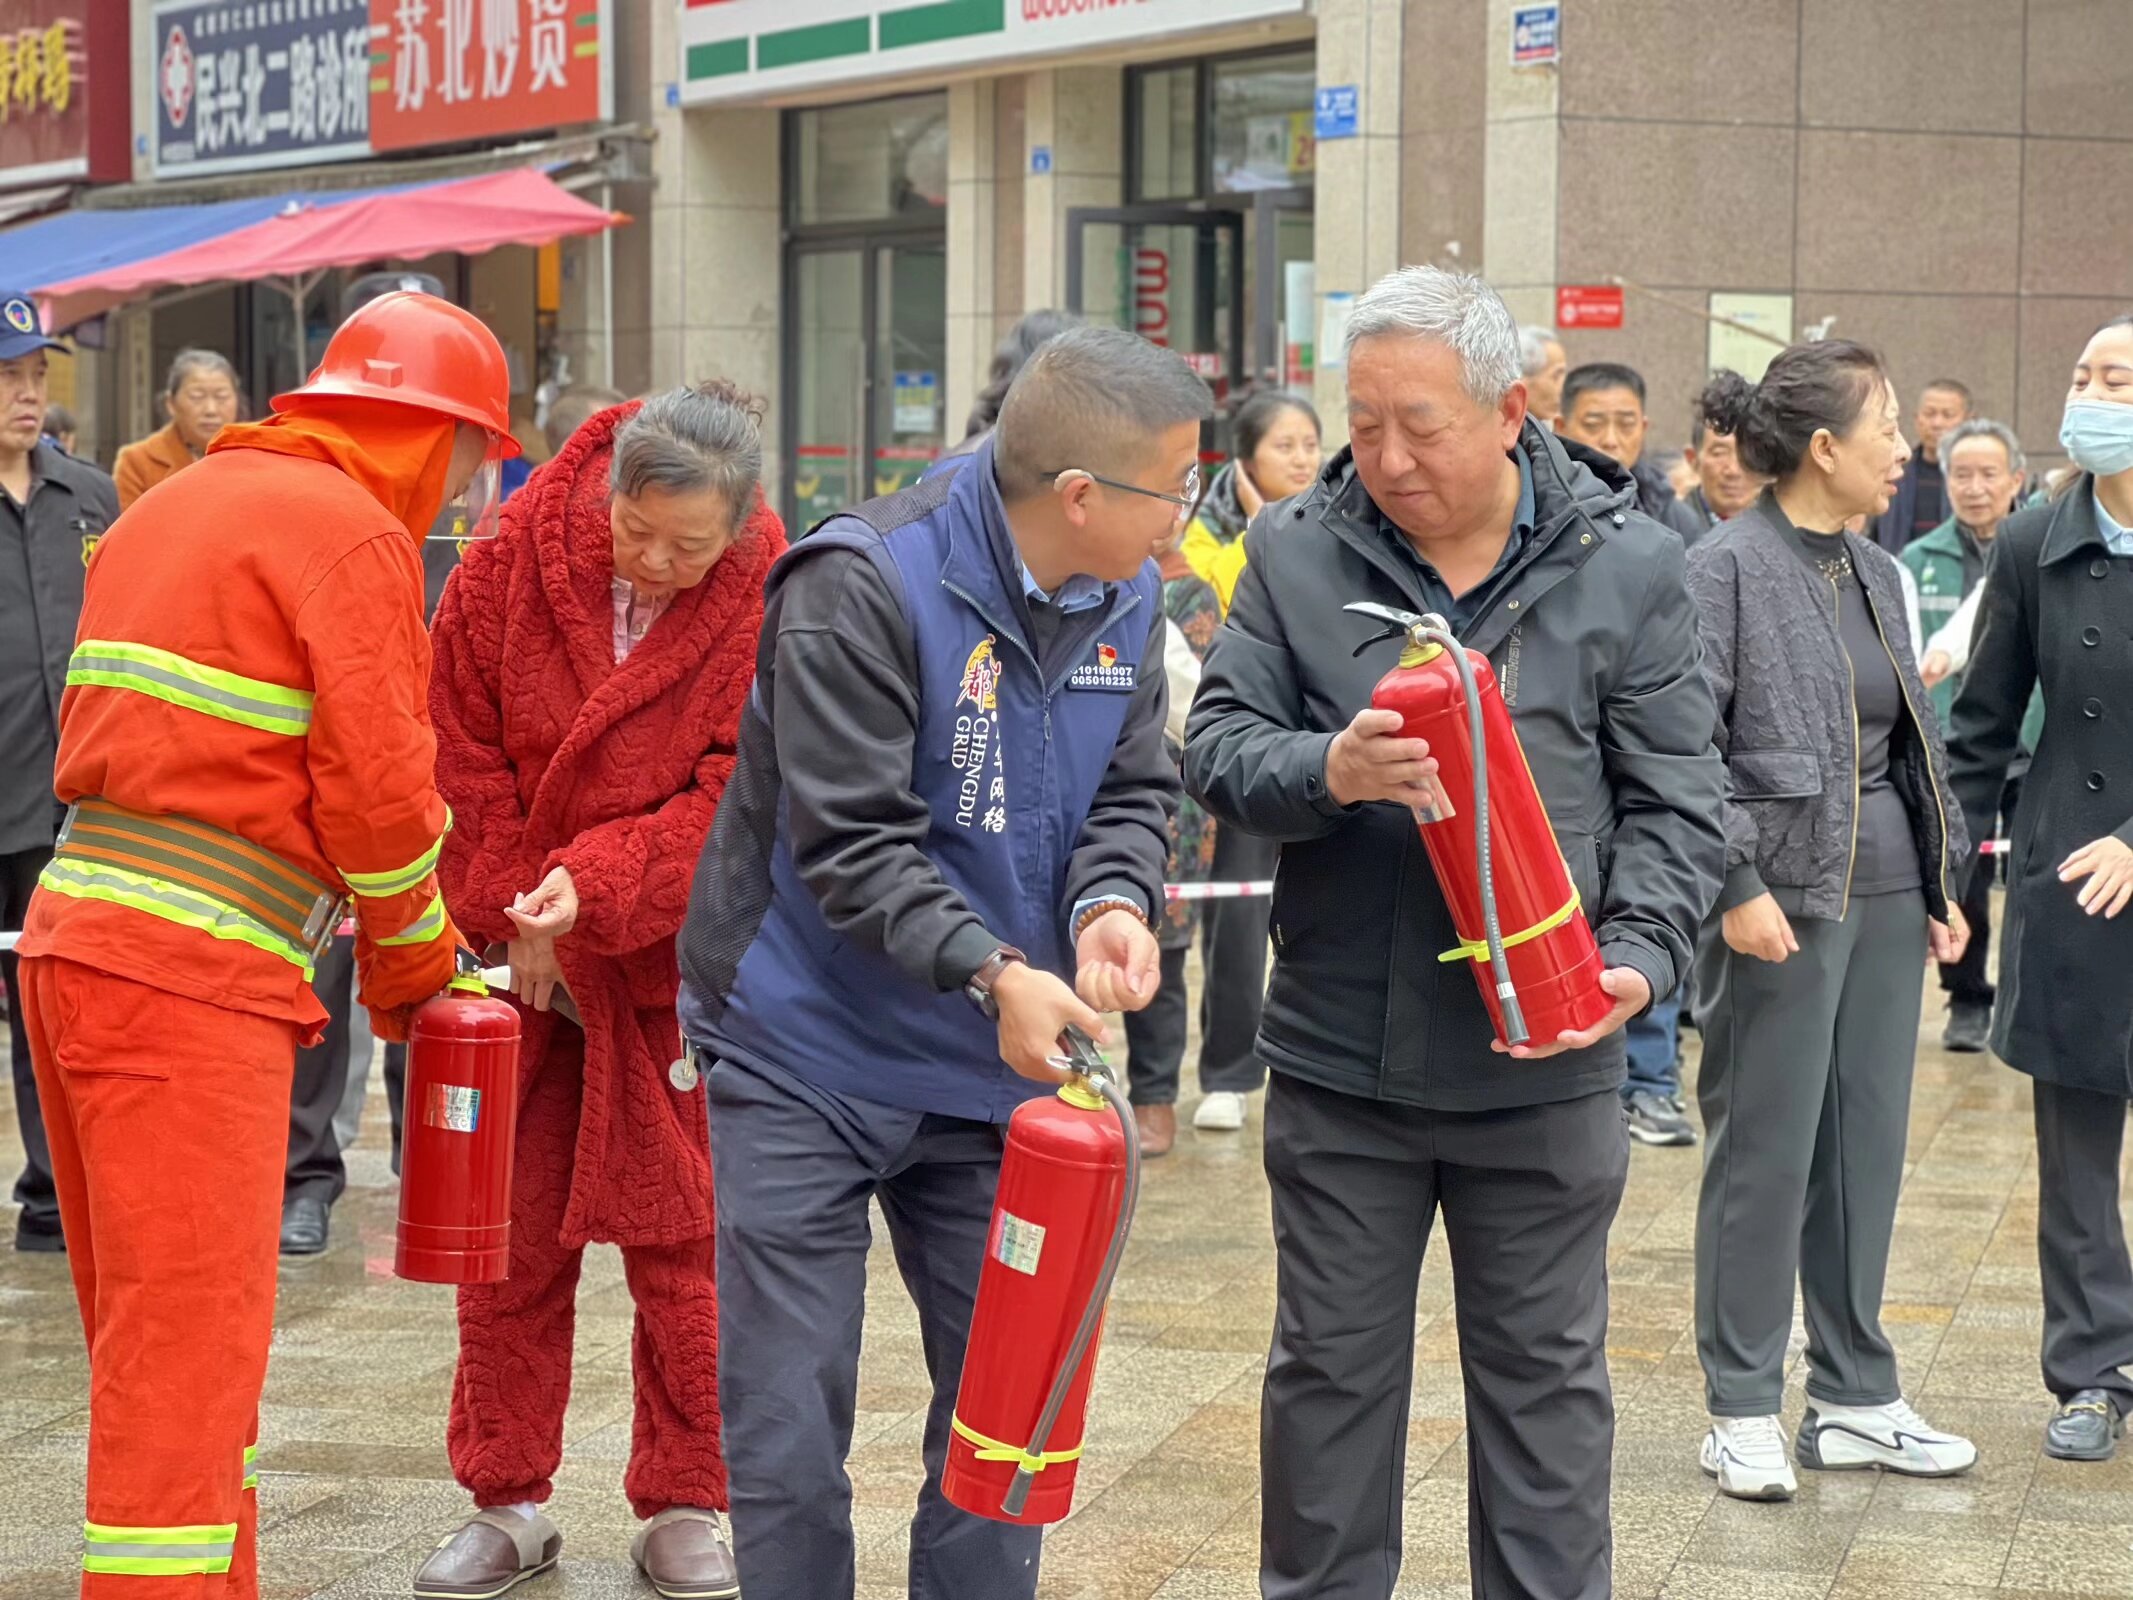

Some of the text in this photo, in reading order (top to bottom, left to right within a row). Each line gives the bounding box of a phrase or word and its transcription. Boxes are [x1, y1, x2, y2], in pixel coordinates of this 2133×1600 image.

[1071, 675, 1133, 686] 005010223
[1504, 624, 1522, 707] FASHION
[951, 715, 972, 769] GRID
[955, 717, 990, 828] CHENGDU
